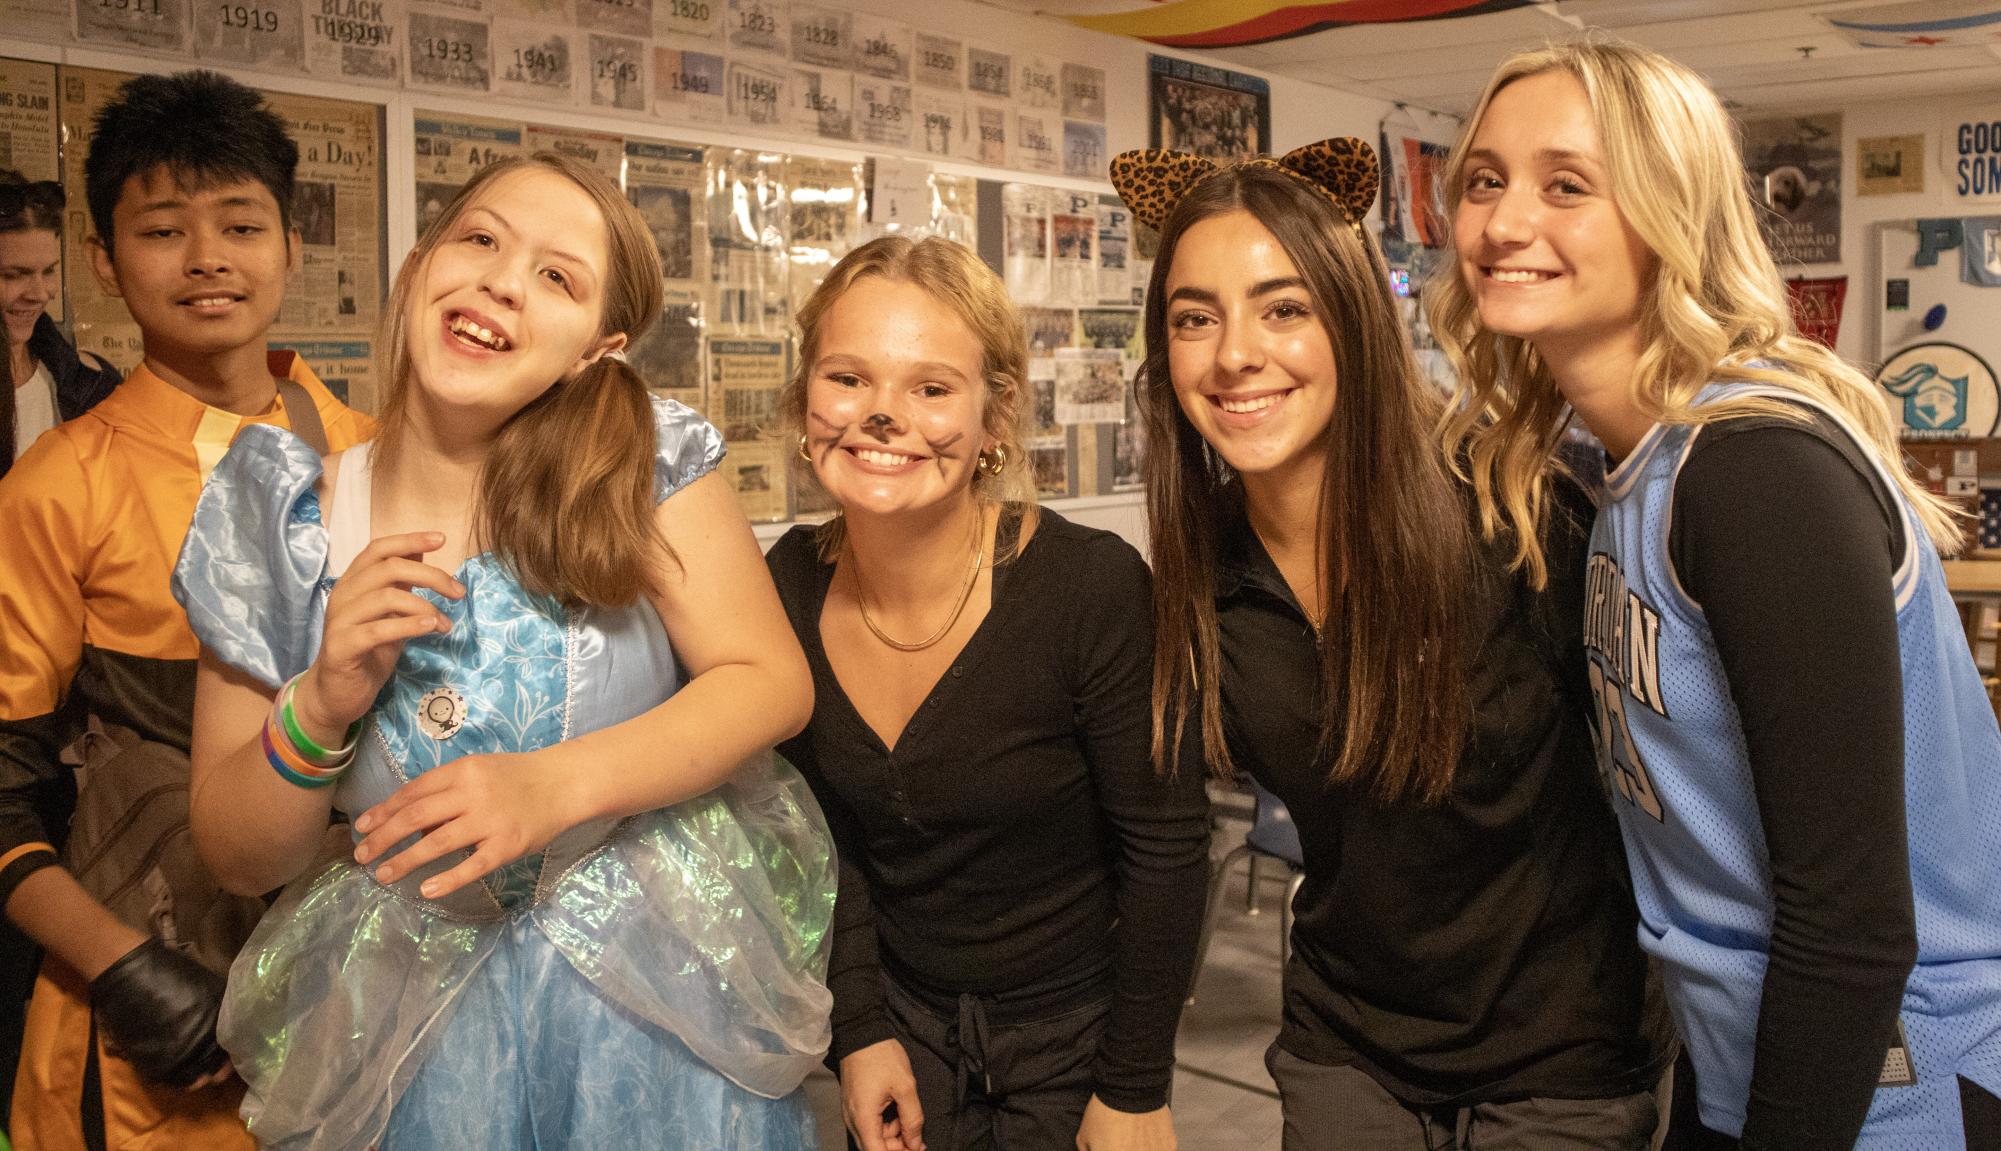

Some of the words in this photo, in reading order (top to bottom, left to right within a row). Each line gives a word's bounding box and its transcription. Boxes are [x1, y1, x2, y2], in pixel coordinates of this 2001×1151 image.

[220, 4, 278, 32] 1919
[671, 0, 710, 21] 1820
[740, 12, 775, 34] 1823
[424, 38, 473, 63] 1933
[597, 60, 637, 82] 1945
[17, 93, 49, 111] SLAIN
[742, 83, 777, 104] 1954
[307, 147, 319, 163] a
[325, 140, 373, 173] Day!
[1071, 196, 1088, 213] P
[1110, 211, 1126, 228] P
